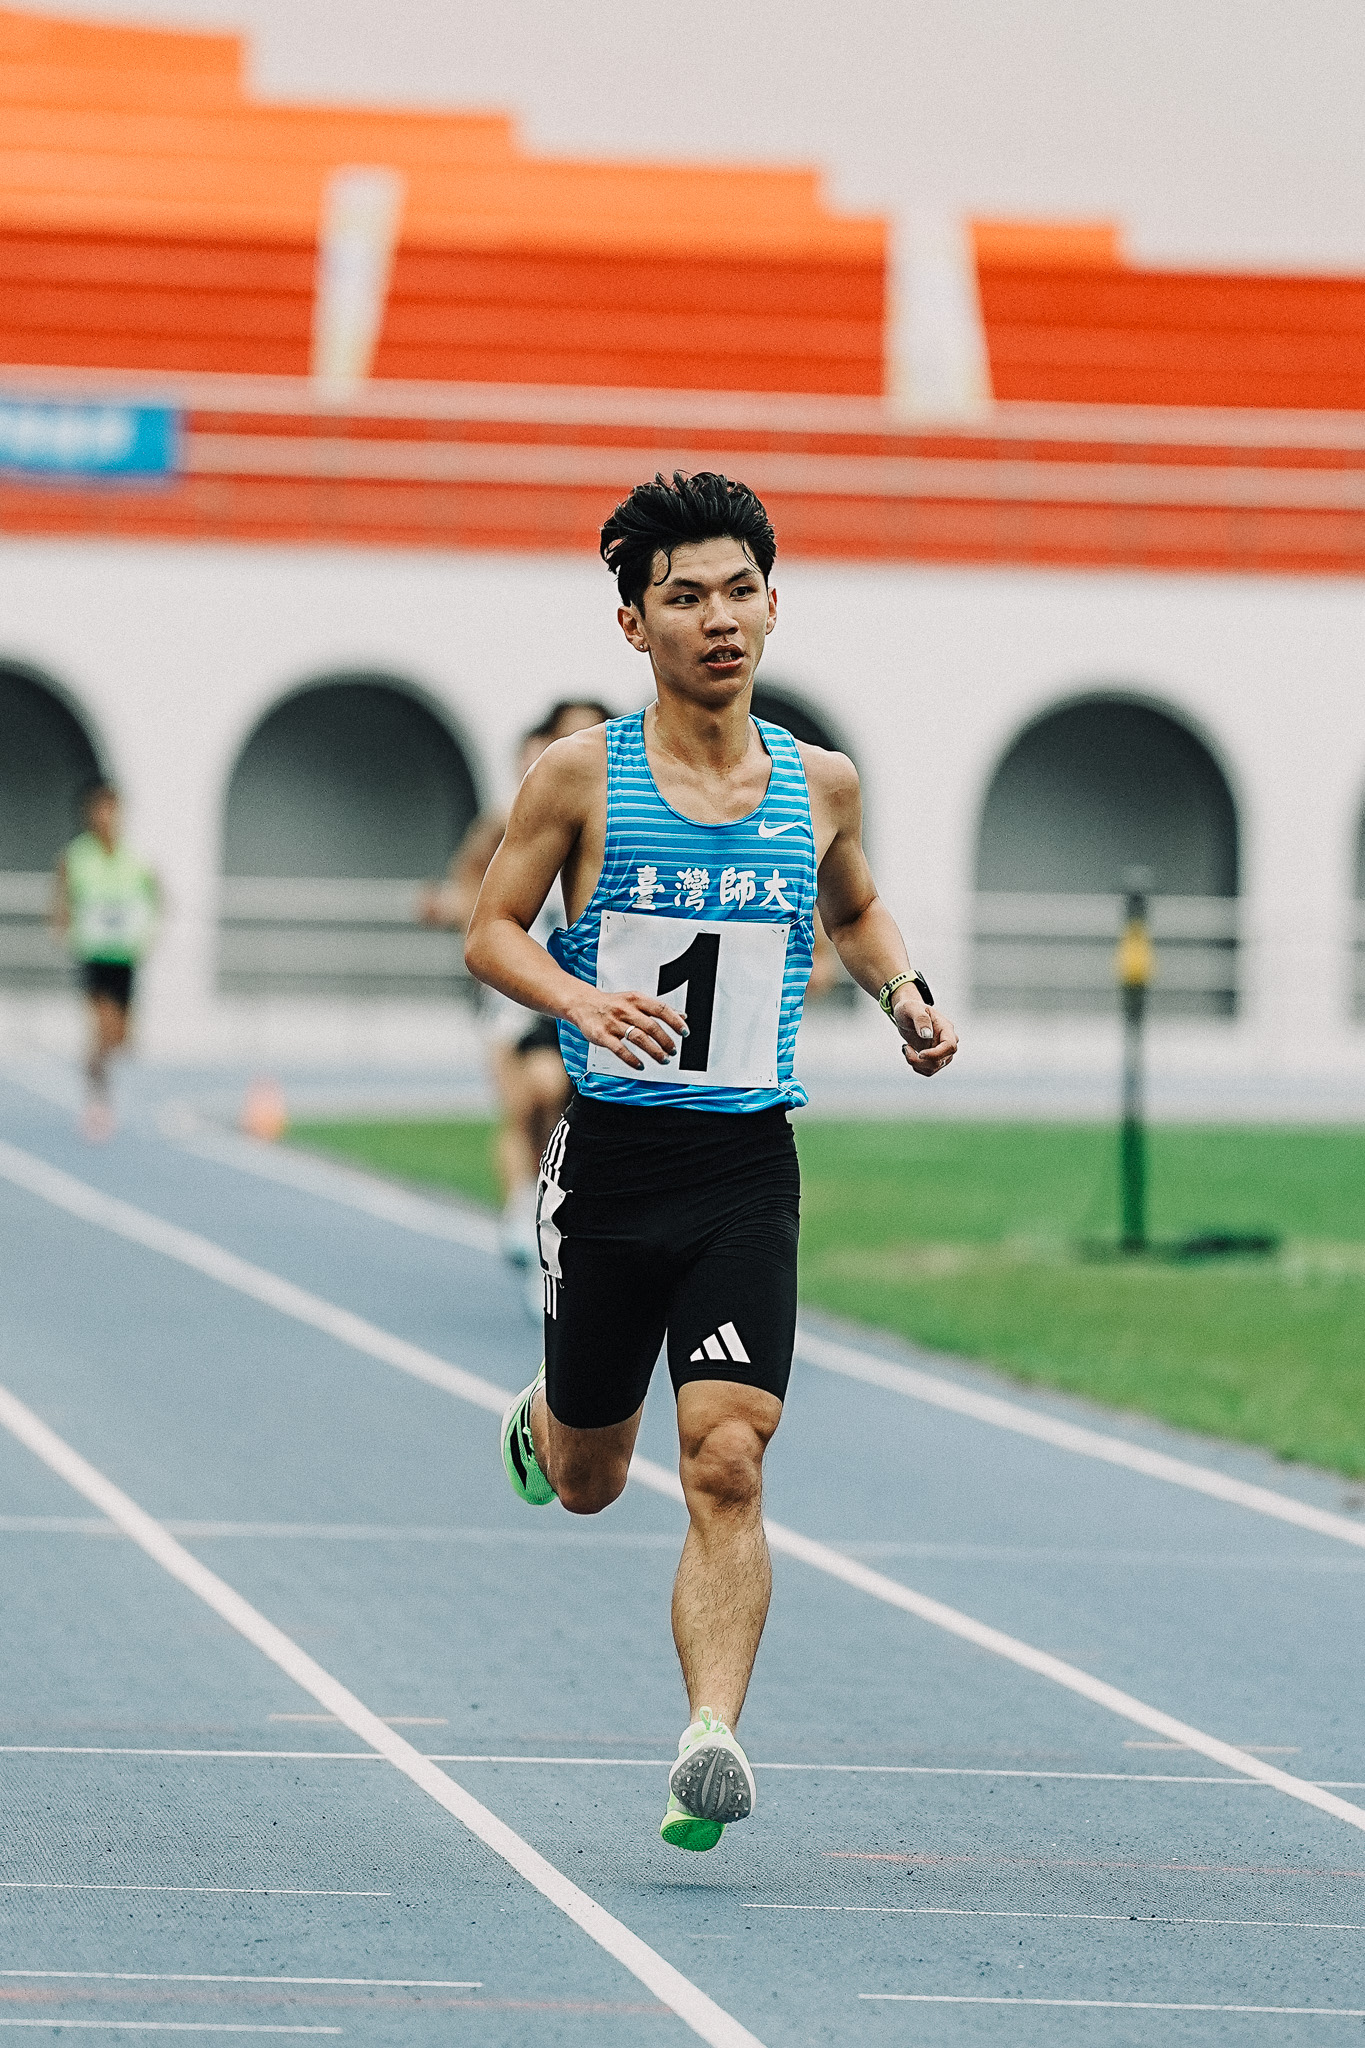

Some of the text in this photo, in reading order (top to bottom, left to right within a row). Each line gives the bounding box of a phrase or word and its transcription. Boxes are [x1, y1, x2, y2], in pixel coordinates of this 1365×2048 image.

[630, 865, 796, 911] 臺灣師大
[657, 932, 721, 1072] 1
